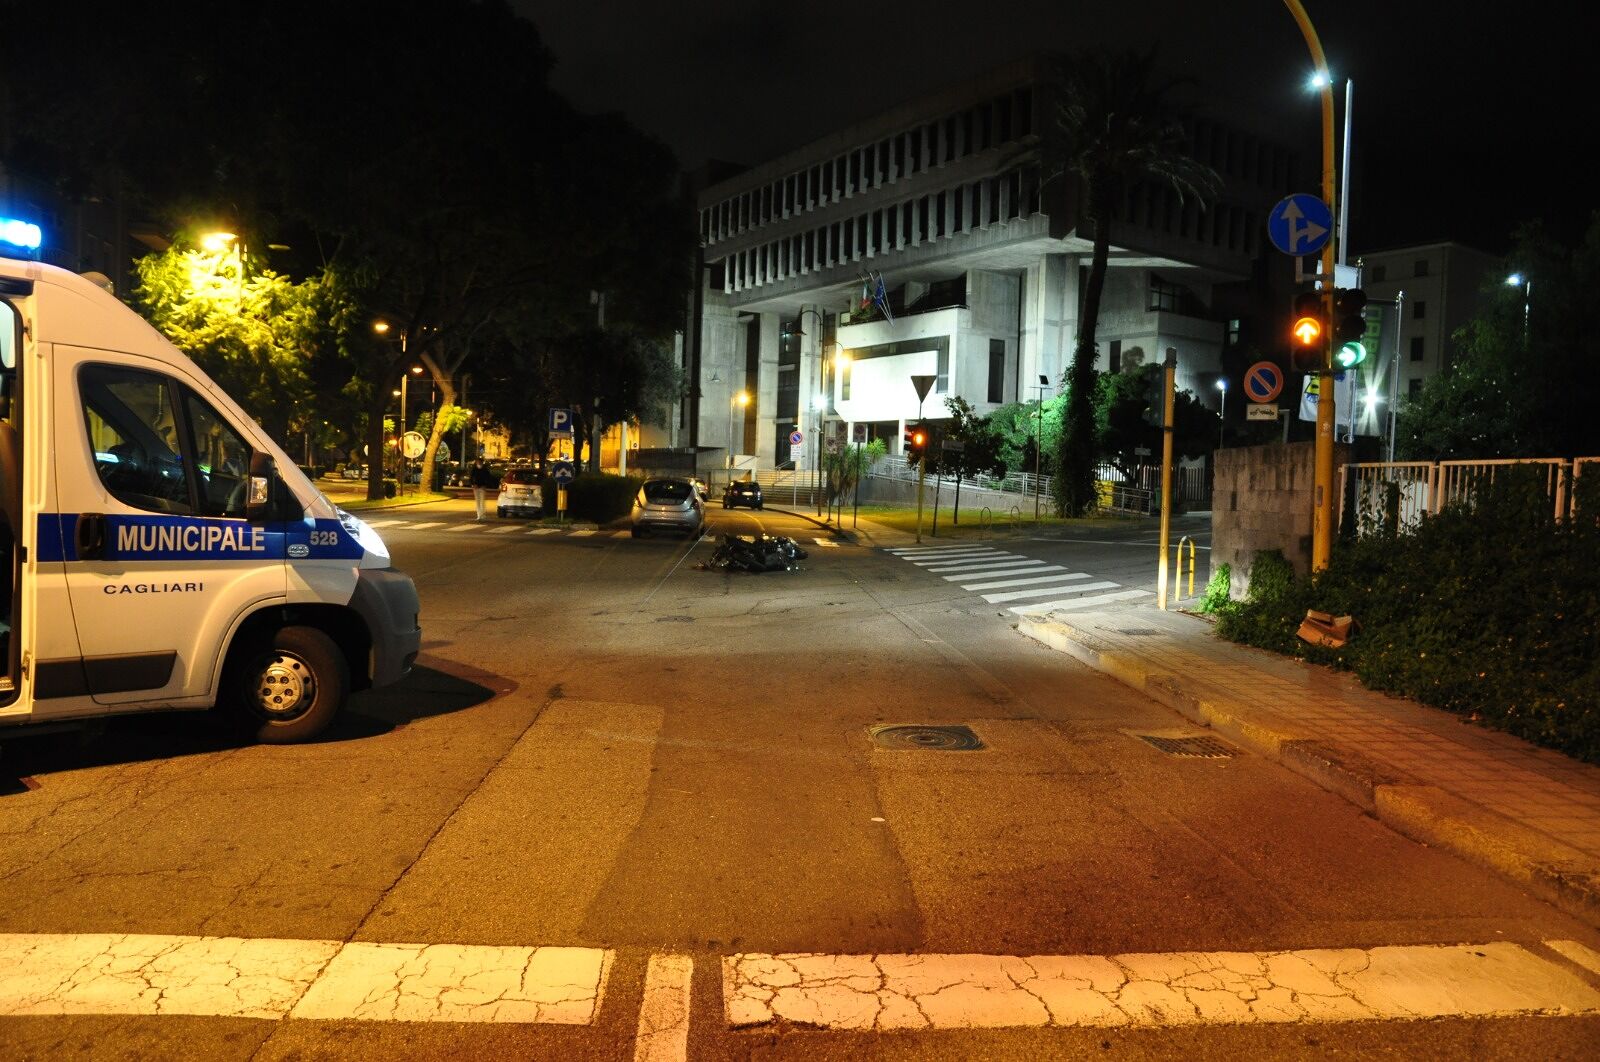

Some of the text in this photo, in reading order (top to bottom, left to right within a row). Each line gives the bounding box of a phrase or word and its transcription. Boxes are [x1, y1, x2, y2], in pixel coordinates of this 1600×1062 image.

[553, 410, 568, 430] P
[117, 525, 265, 552] MUNICIPALE
[309, 530, 338, 546] 528
[103, 582, 204, 595] CAGLIARI
